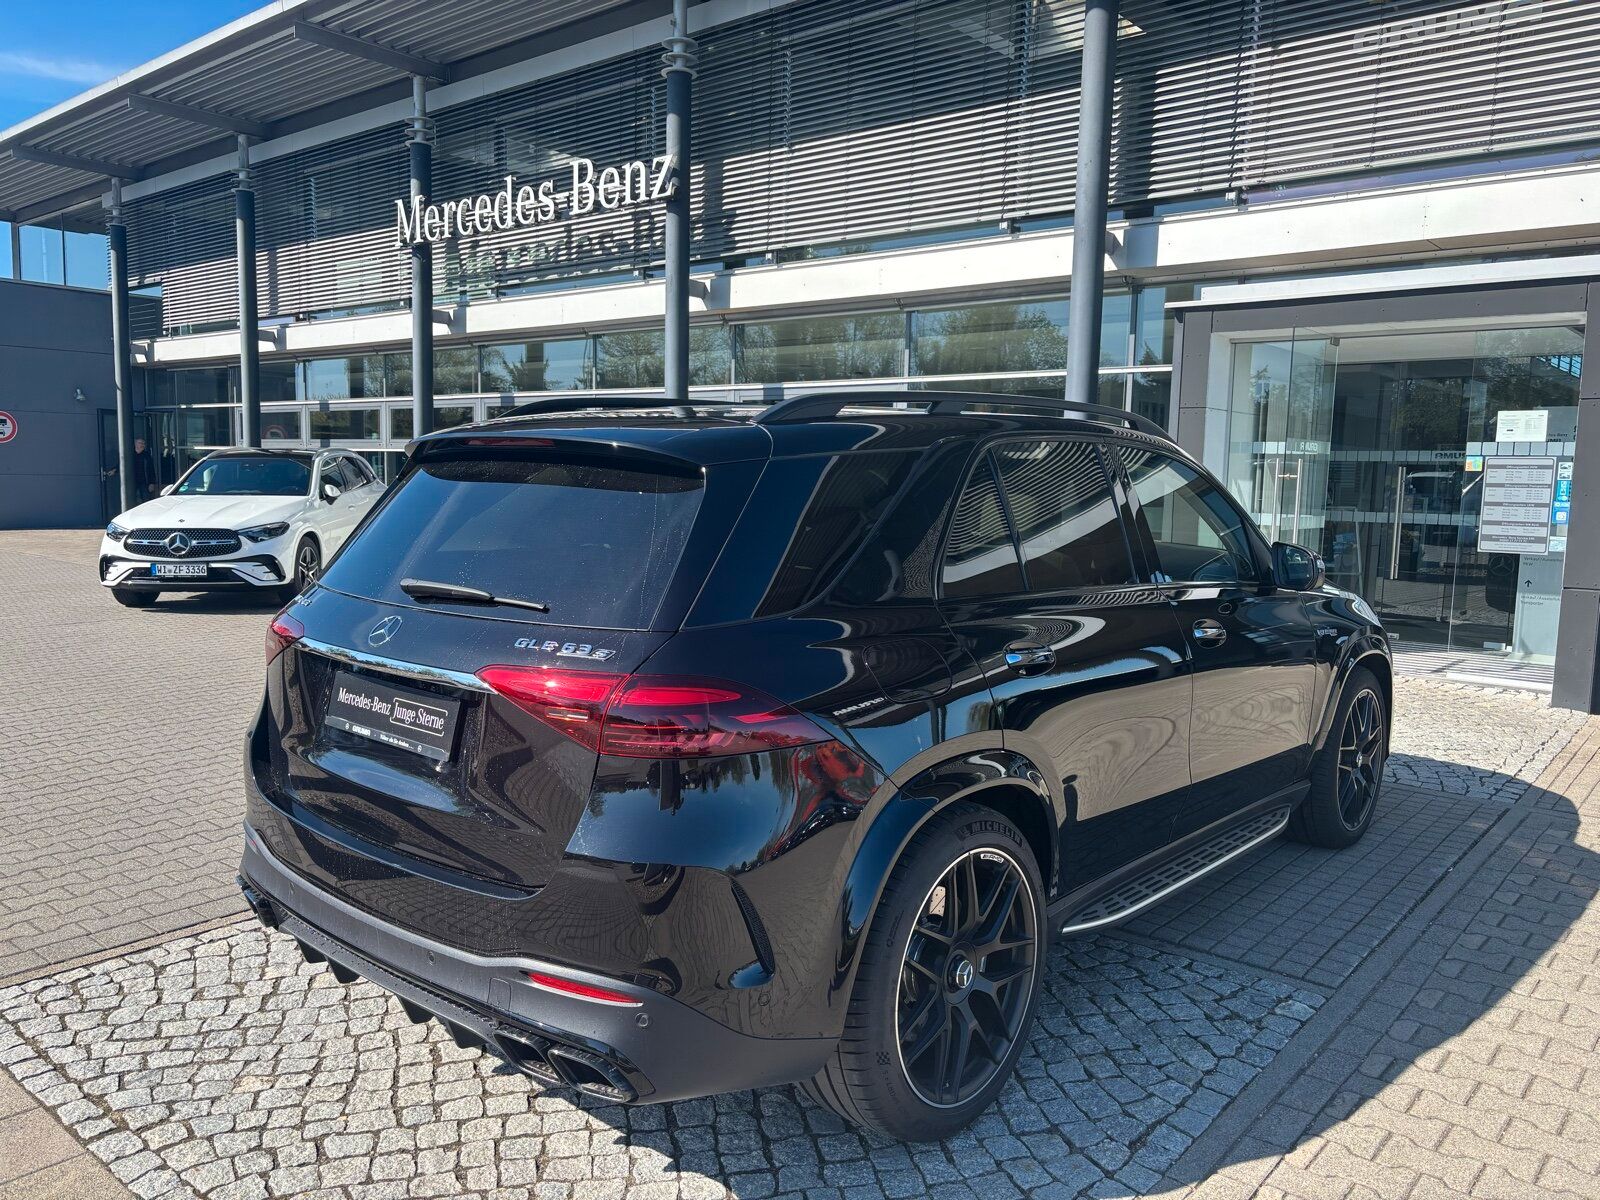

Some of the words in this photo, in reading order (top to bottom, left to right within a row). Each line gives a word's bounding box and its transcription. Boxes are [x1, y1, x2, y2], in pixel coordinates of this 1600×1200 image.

[394, 153, 675, 247] Mercedes-Benz
[173, 566, 183, 574] ZF
[514, 637, 559, 652] GLE
[337, 687, 392, 717] Mercedes-Benz
[392, 702, 416, 725] Junge
[416, 708, 445, 731] Sterne
